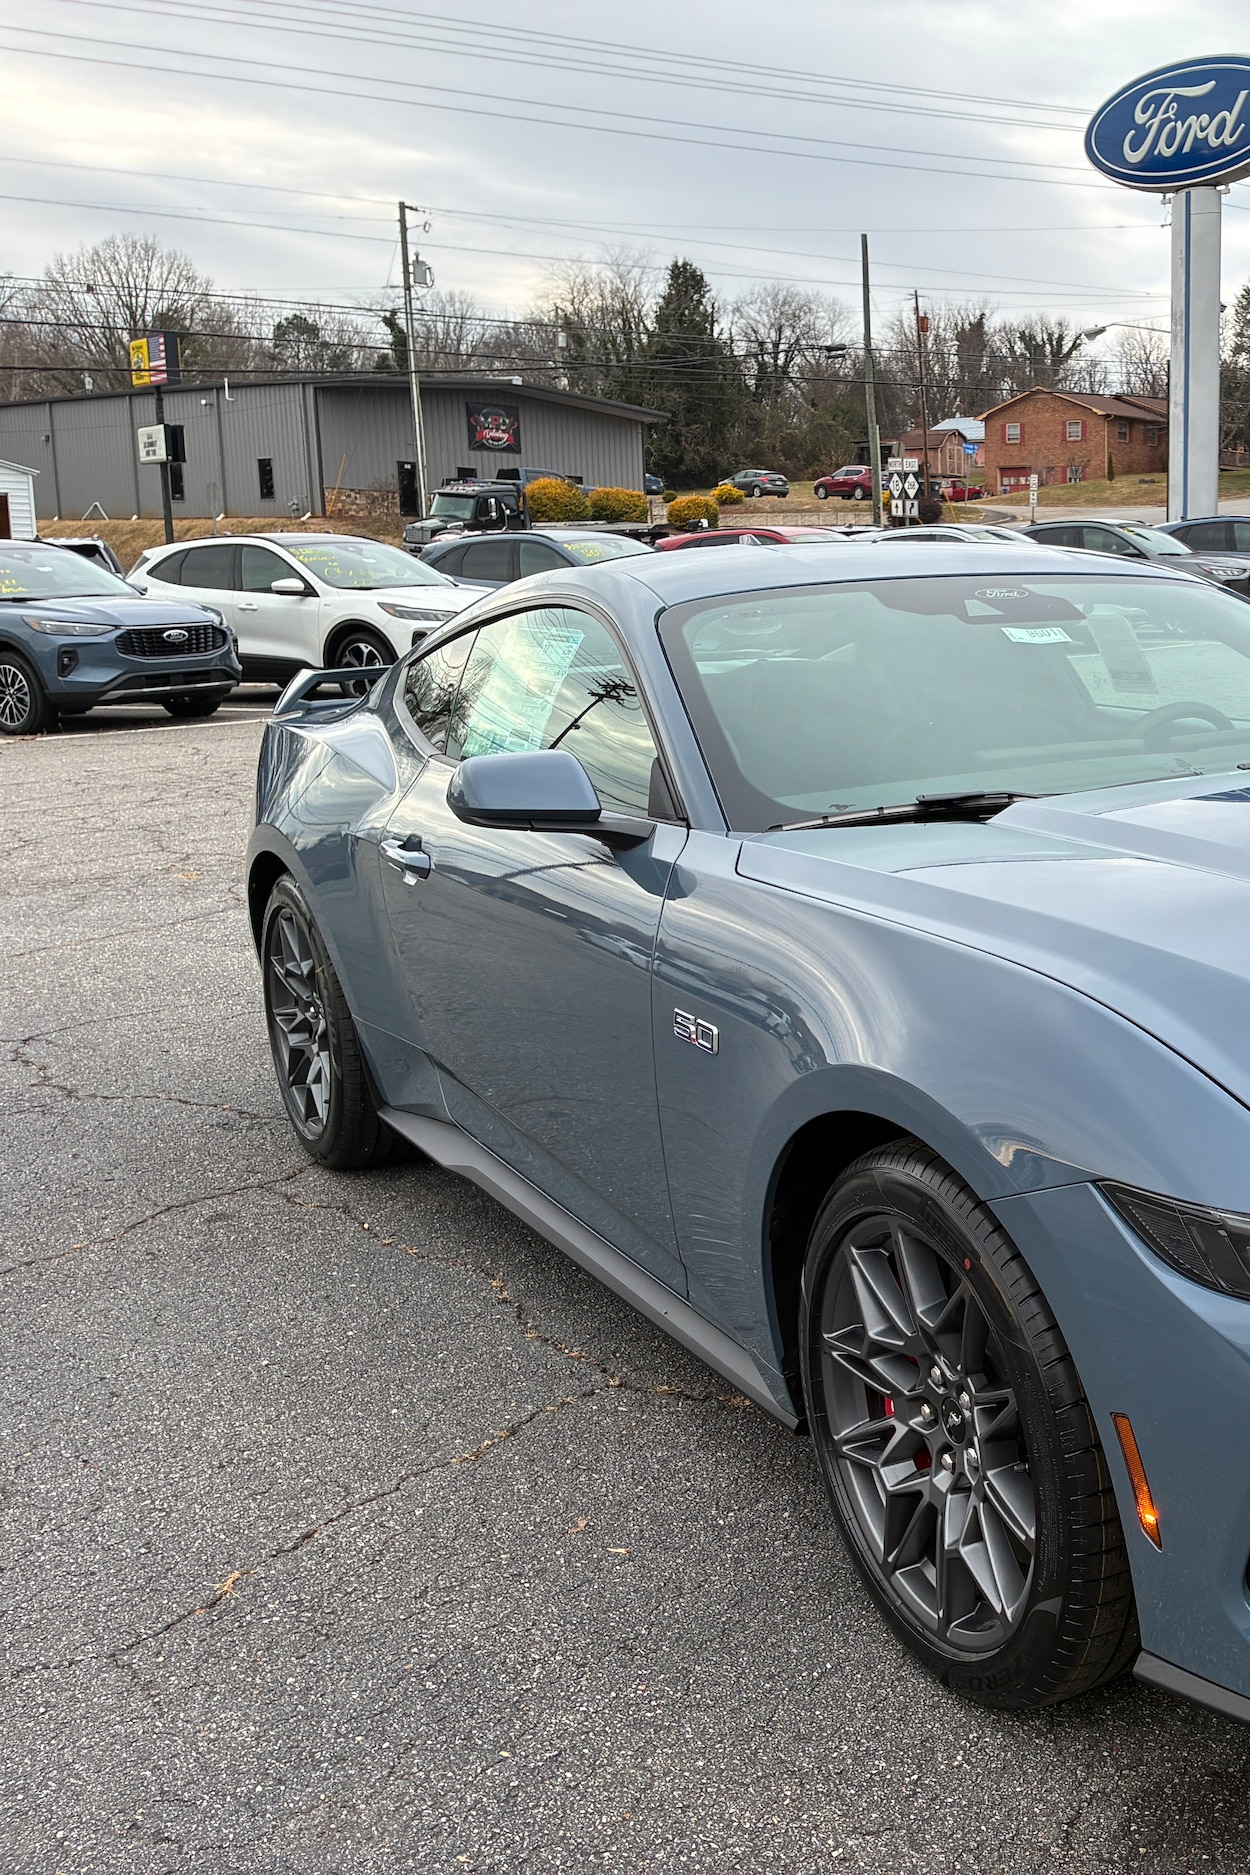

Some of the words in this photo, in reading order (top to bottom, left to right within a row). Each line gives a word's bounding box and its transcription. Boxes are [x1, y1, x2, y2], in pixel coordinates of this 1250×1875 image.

[1123, 80, 1250, 163] Ford
[905, 460, 916, 468] EAST
[892, 480, 900, 491] 18
[985, 589, 1020, 598] Ford
[673, 1007, 719, 1055] 5.0
